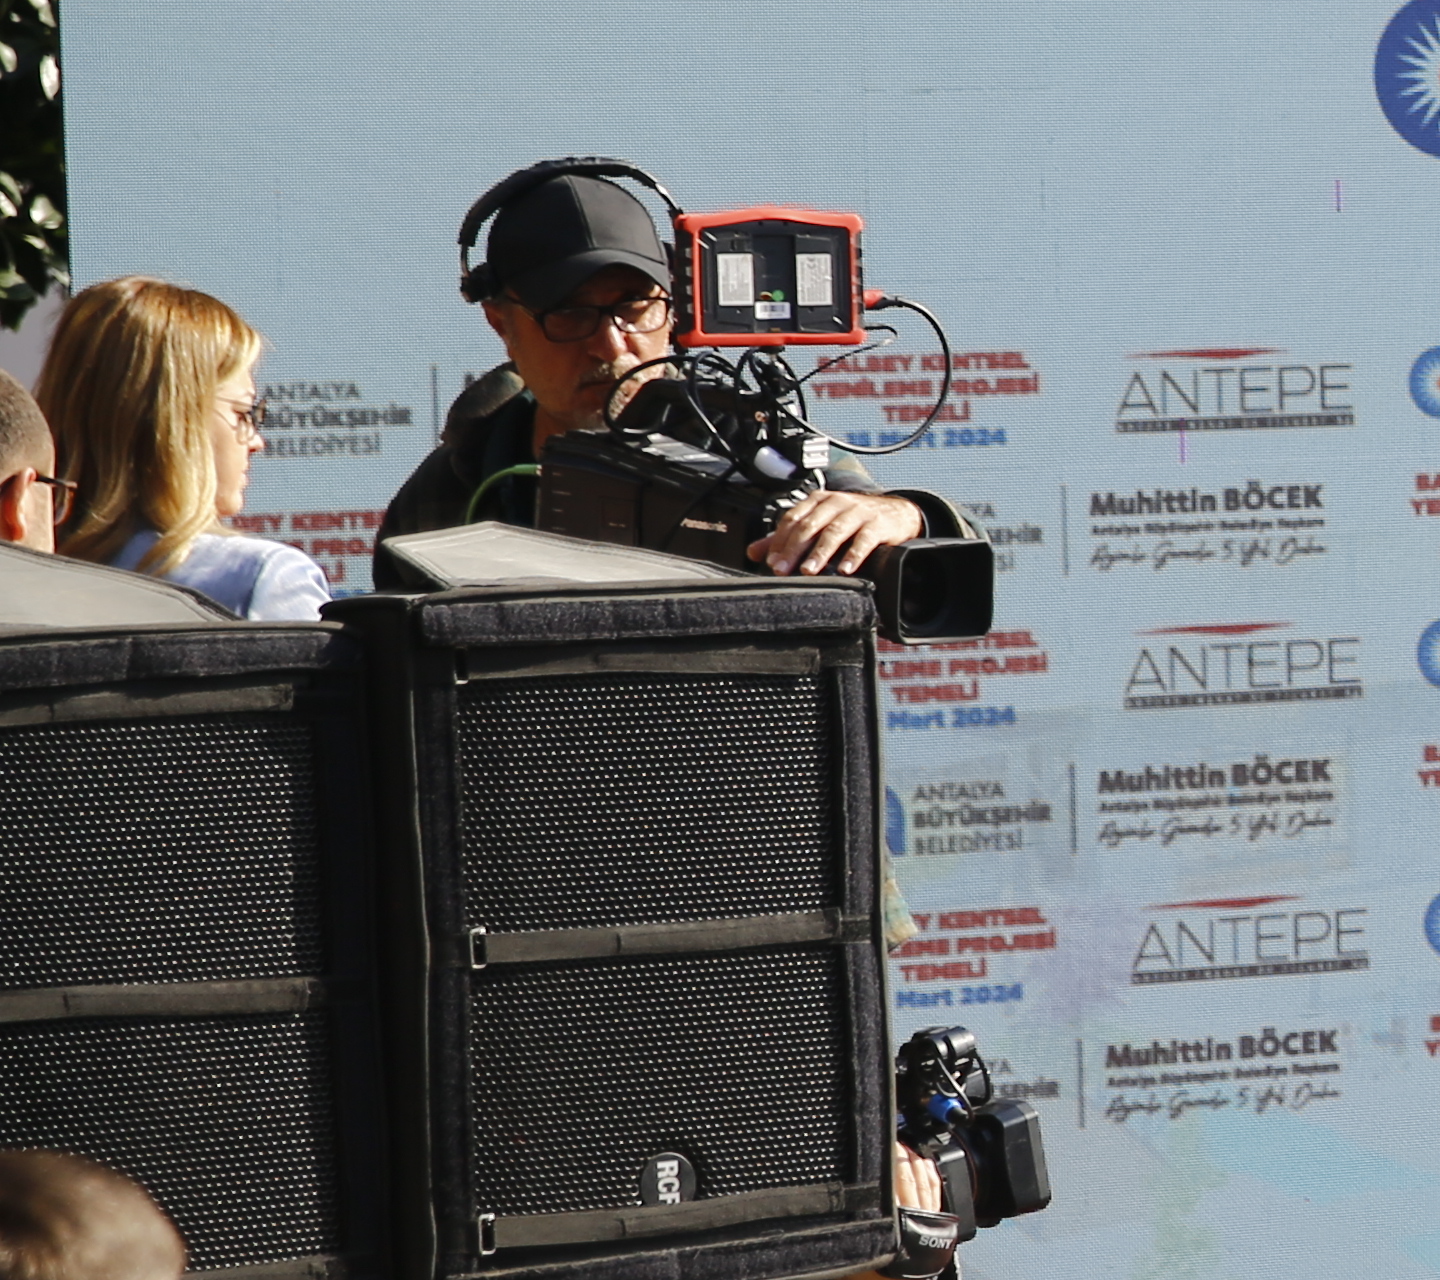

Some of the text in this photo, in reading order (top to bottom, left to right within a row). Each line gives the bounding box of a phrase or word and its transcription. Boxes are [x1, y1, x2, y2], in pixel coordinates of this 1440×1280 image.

[1117, 364, 1354, 418] ANTEPE
[1090, 480, 1324, 518] Muhittin BÖCEK
[1127, 638, 1362, 693] ANTEPE
[1098, 755, 1331, 793] Muhittin BÖCEK
[1133, 910, 1368, 969] ANTEPE
[1106, 1028, 1338, 1068] Muhittin BÖCEK
[656, 1159, 681, 1205] RCF
[918, 1235, 953, 1250] SONY
